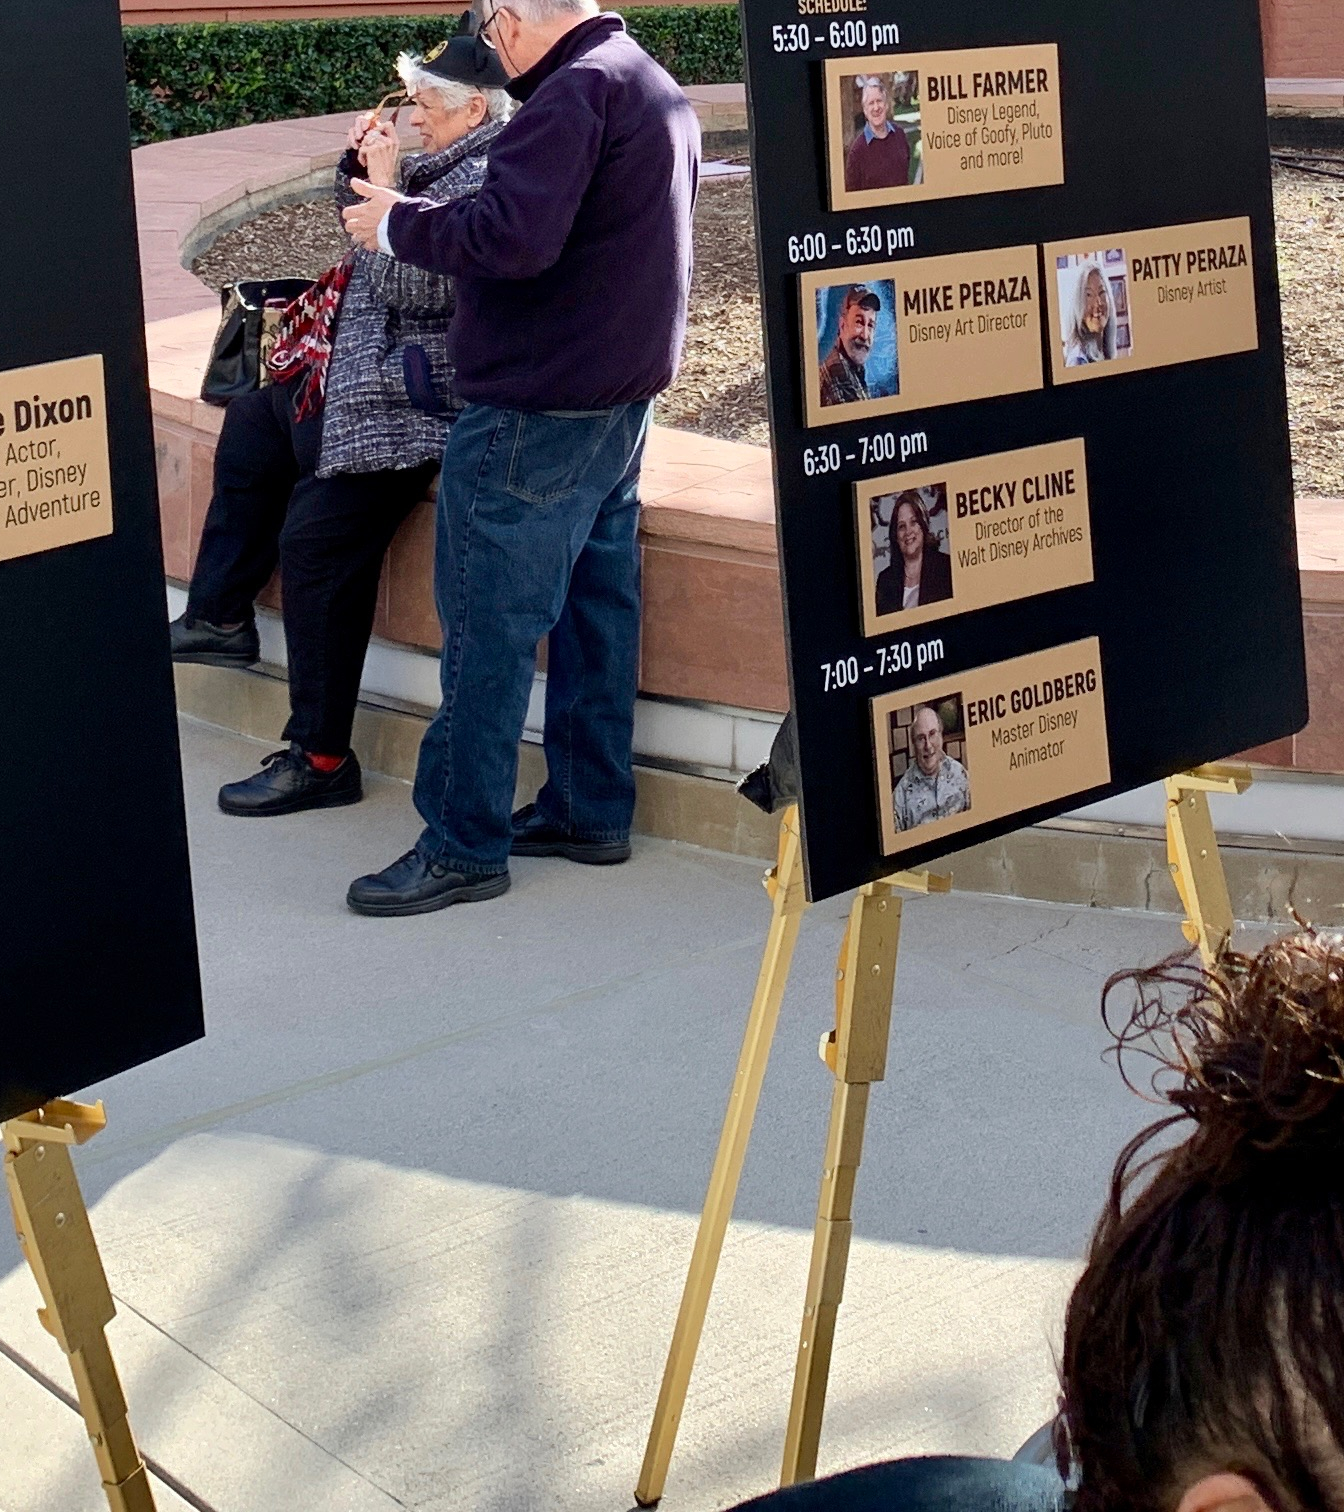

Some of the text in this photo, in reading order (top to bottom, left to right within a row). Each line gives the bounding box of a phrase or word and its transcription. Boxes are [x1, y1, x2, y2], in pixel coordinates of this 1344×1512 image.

[772, 20, 900, 53] 5:30 6:00 pm
[926, 67, 1049, 103] BILL FARMER
[947, 99, 1040, 126] Disney Legend,
[926, 122, 1053, 151] Voice of Goofy, Pluto
[959, 146, 1024, 171] and more!
[787, 224, 915, 264] 6:00 6:30 pm
[1131, 243, 1248, 283] PATTY PERAZA
[902, 274, 1032, 318] MIKE PERAZA
[1156, 277, 1228, 306] Disney Artist
[908, 312, 1029, 345] Disney Art Director
[13, 394, 92, 433] Dixon
[5, 436, 61, 469] Actor,
[803, 430, 928, 477] 6:30 7:00 pm
[26, 461, 88, 493] Disney
[955, 468, 1076, 519] BECKY CLINE
[4, 489, 101, 530] Adventure
[975, 514, 1025, 542] Director
[1028, 508, 1043, 529] of
[1043, 504, 1065, 525] the
[957, 524, 1084, 570] Walt Disney Archives
[820, 637, 945, 693] 7:00 7:30 pm
[966, 667, 1097, 728] ERIC GOLDBERG
[991, 708, 1079, 749] Master Disney
